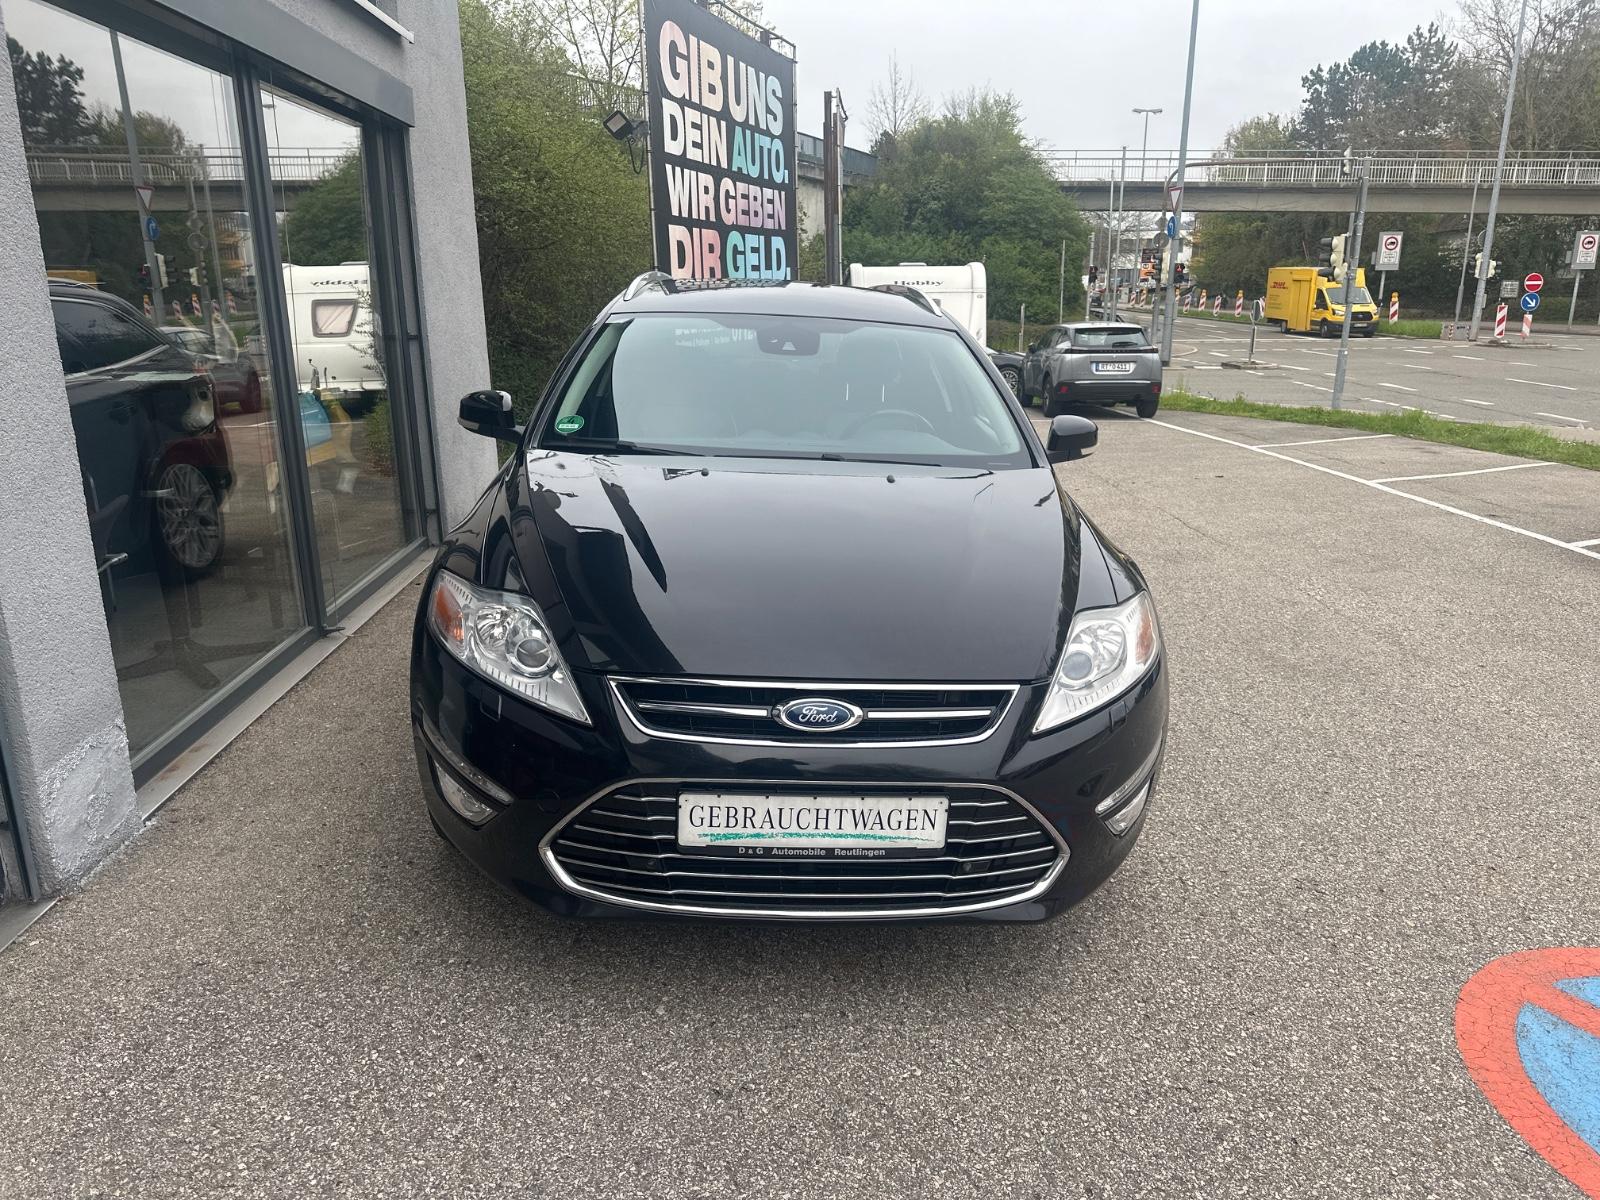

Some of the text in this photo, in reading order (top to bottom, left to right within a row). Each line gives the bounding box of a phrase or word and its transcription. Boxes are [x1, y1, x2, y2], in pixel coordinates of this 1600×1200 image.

[659, 20, 783, 136] GIB UNS
[661, 98, 789, 184] DEIN AUTO.
[665, 164, 786, 230] WIR GEBEN
[668, 223, 791, 281] DIR GELD.
[798, 706, 838, 723] Ford
[689, 804, 939, 831] GEBRAUCHTWAGEN
[756, 847, 764, 855] G
[772, 847, 826, 856] Automobile
[834, 848, 886, 857] Reutlingen
